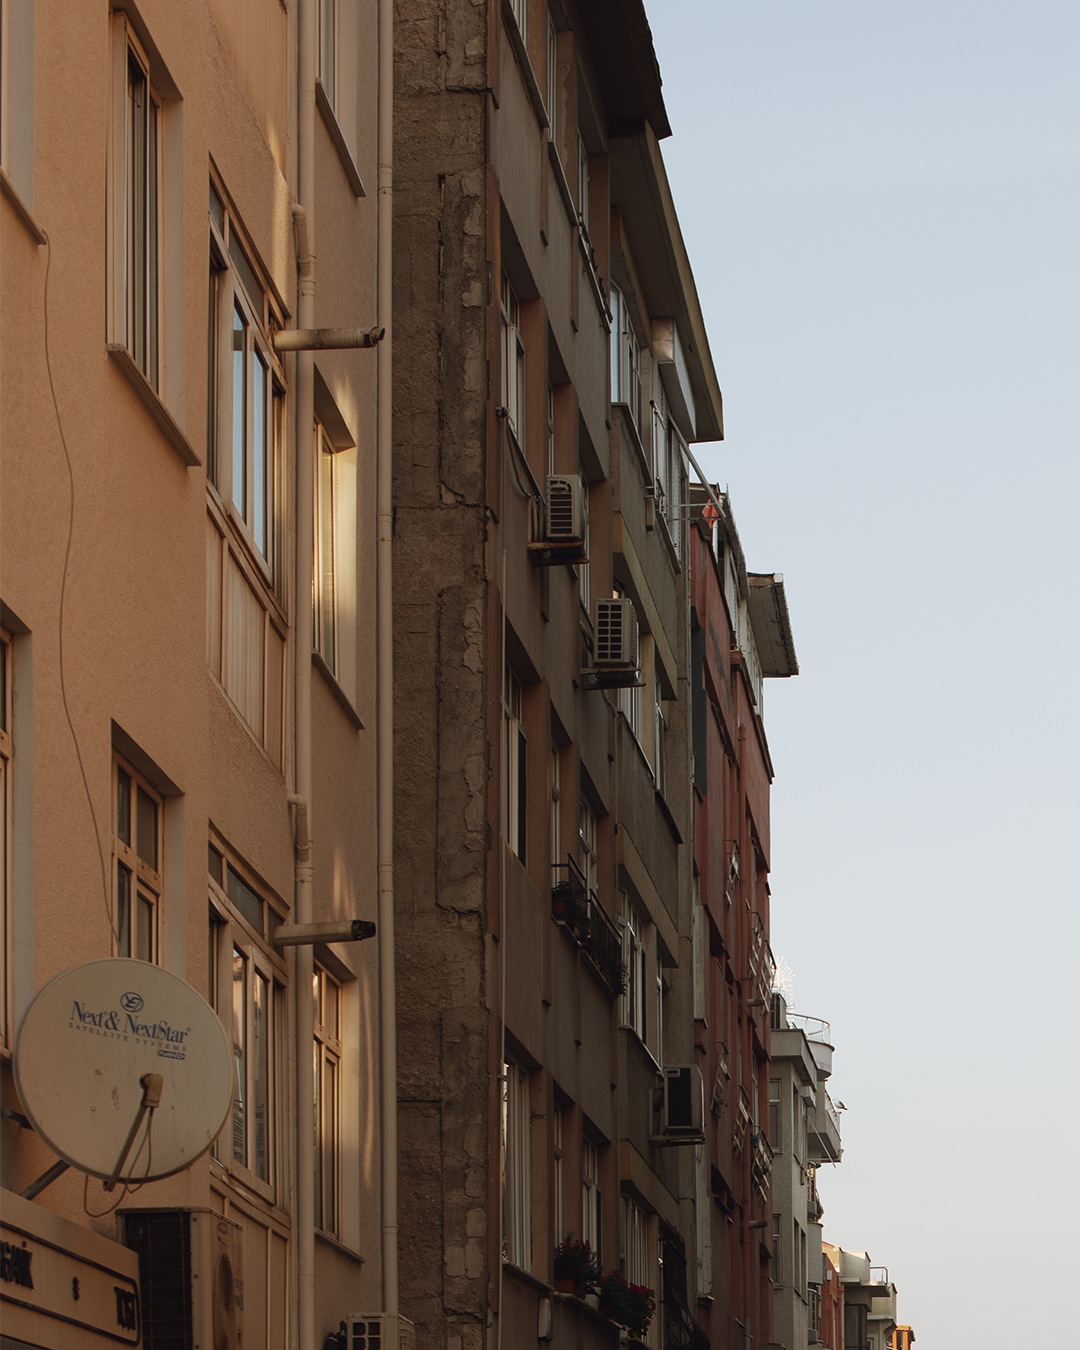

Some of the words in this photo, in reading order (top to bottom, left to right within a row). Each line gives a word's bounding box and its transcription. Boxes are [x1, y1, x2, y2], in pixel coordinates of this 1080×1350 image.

[68, 1021, 129, 1042] SATELLITE
[135, 1038, 187, 1053] SYSTEMS
[70, 1000, 103, 1028] Next
[104, 1010, 121, 1032] &
[123, 1013, 188, 1043] NextStar
